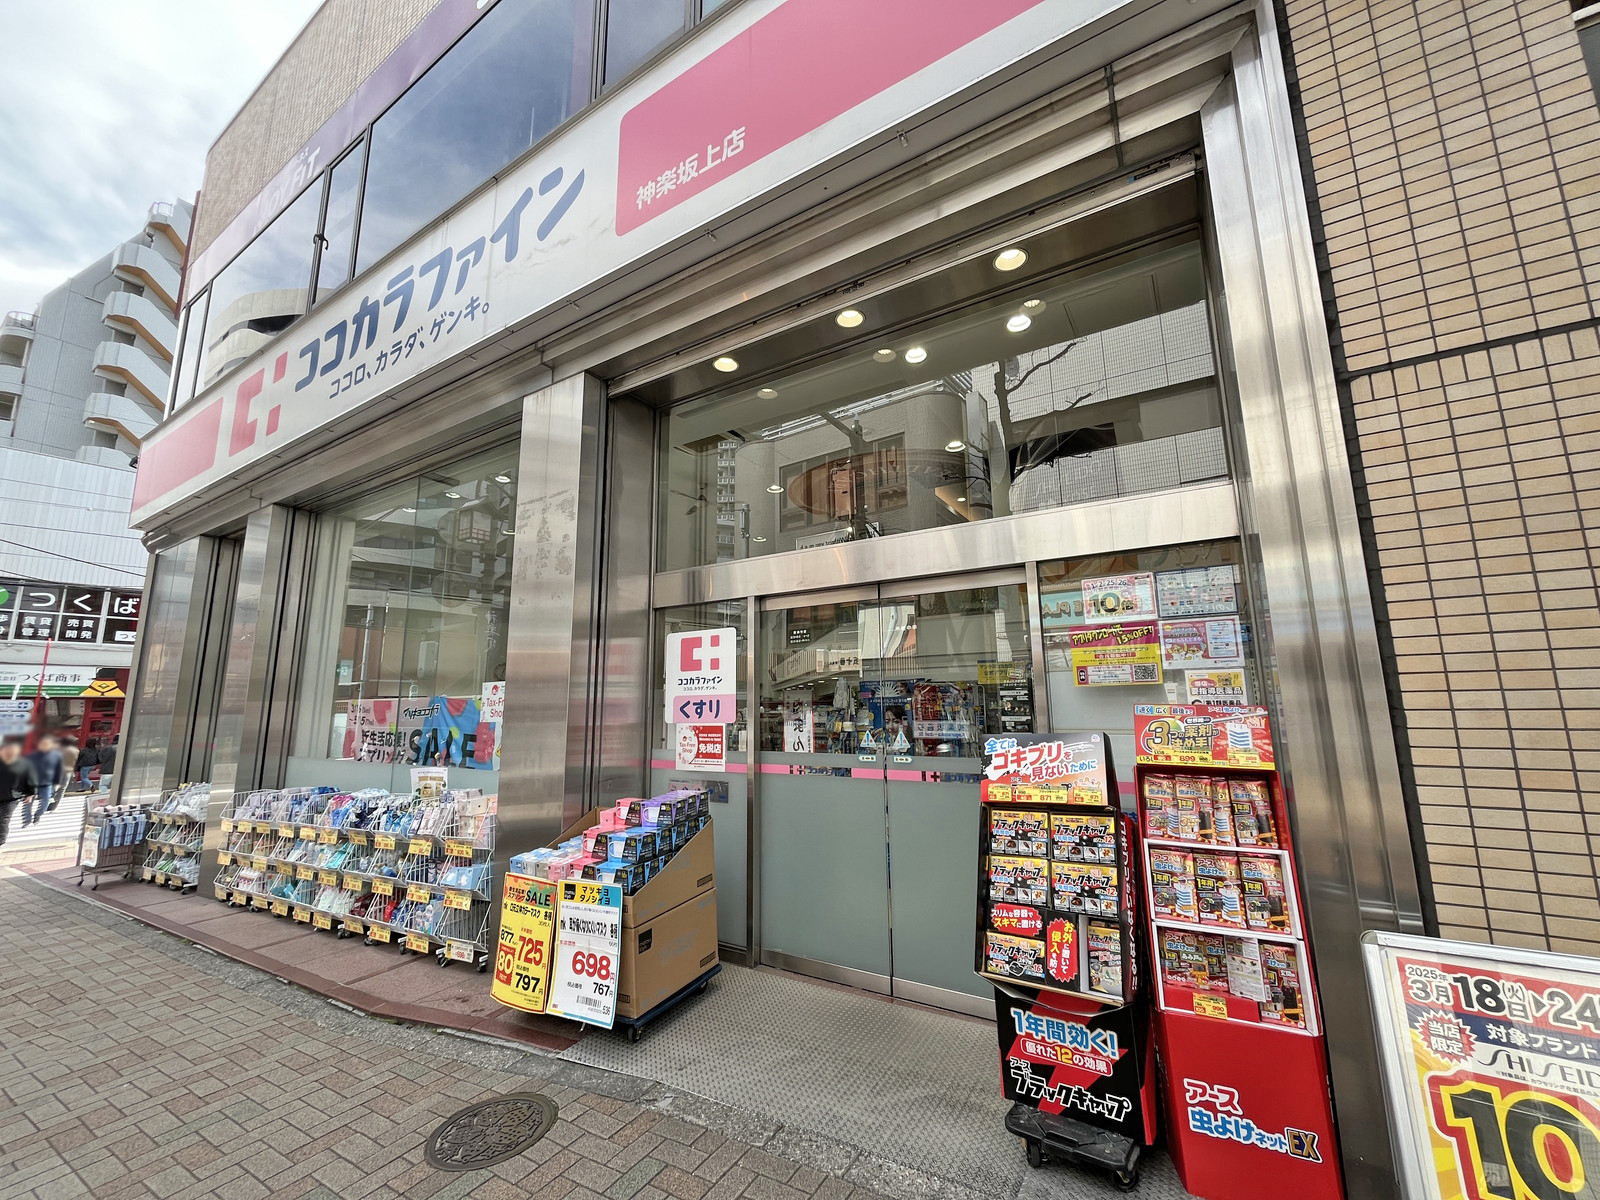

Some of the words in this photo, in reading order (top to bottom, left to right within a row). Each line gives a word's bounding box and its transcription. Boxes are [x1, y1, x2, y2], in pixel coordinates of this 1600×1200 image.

[636, 127, 747, 210] 神楽坂上店
[295, 166, 585, 392] ココカラファイン
[329, 300, 492, 400] ココロ、カラダ、ゲンキ。
[29, 593, 140, 615] つくば
[24, 616, 52, 626] 賃貸
[67, 619, 94, 629] 売買
[22, 627, 50, 637] 管理
[65, 630, 92, 639] 開発
[678, 676, 722, 686] ココカラファイン
[679, 699, 720, 719] くすり
[698, 743, 722, 754] 免税店
[985, 738, 1017, 754] 全ては
[993, 743, 1071, 770] ゴキブリを
[1031, 760, 1097, 781] 見ないために
[526, 890, 550, 906] SALE
[580, 895, 610, 906] タノシイヨ
[582, 886, 609, 897] マツキヨ
[991, 908, 1033, 918] スリムな容器で
[501, 929, 514, 943] 877
[517, 936, 544, 966] 725
[498, 950, 514, 975] 80
[572, 950, 611, 981] 698
[515, 973, 540, 993] 797
[1407, 966, 1448, 981] 2025年
[593, 982, 610, 995] 767
[1410, 980, 1451, 1005] 3月
[1453, 975, 1505, 1014] 18
[1508, 1002, 1530, 1021] 日
[1546, 990, 1600, 1033] 24
[1011, 1009, 1118, 1058] 1年間効く!
[1428, 1020, 1460, 1039] 当店
[1430, 1036, 1463, 1054] 限定
[1486, 1023, 1598, 1060] 対象ブランド
[1010, 1057, 1032, 1073] アース
[1025, 1041, 1108, 1073] 優れた12の効果
[1011, 1069, 1132, 1122] ブラックキャップ
[1183, 1078, 1243, 1115] アース
